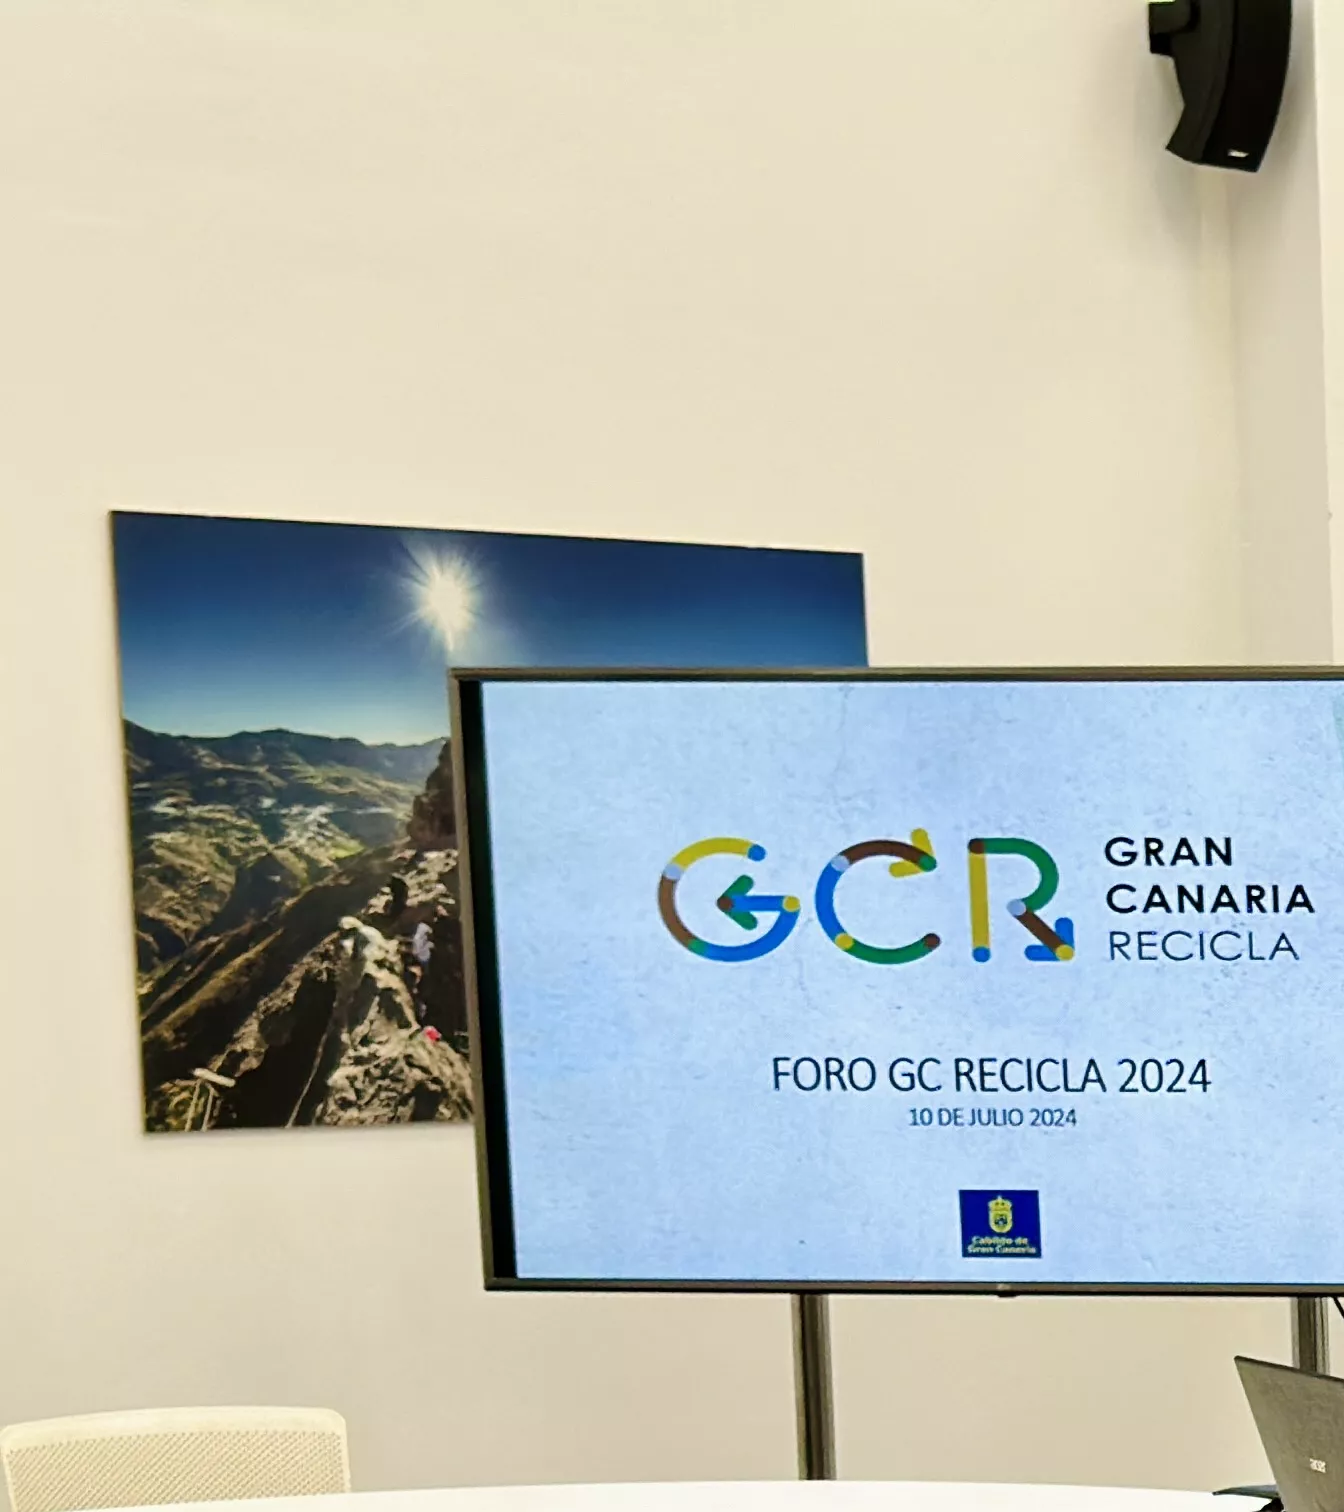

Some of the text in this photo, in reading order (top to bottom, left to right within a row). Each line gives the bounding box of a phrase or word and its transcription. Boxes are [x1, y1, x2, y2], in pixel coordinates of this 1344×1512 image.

[1104, 836, 1233, 867] GRAN
[658, 828, 1076, 964] GCR
[1105, 884, 1315, 914] CANARIA
[1110, 931, 1299, 962] RECICLA
[772, 1056, 1212, 1094] FORO GC RECICLA 2024
[909, 1108, 1078, 1128] 10 DE JULIO 2024
